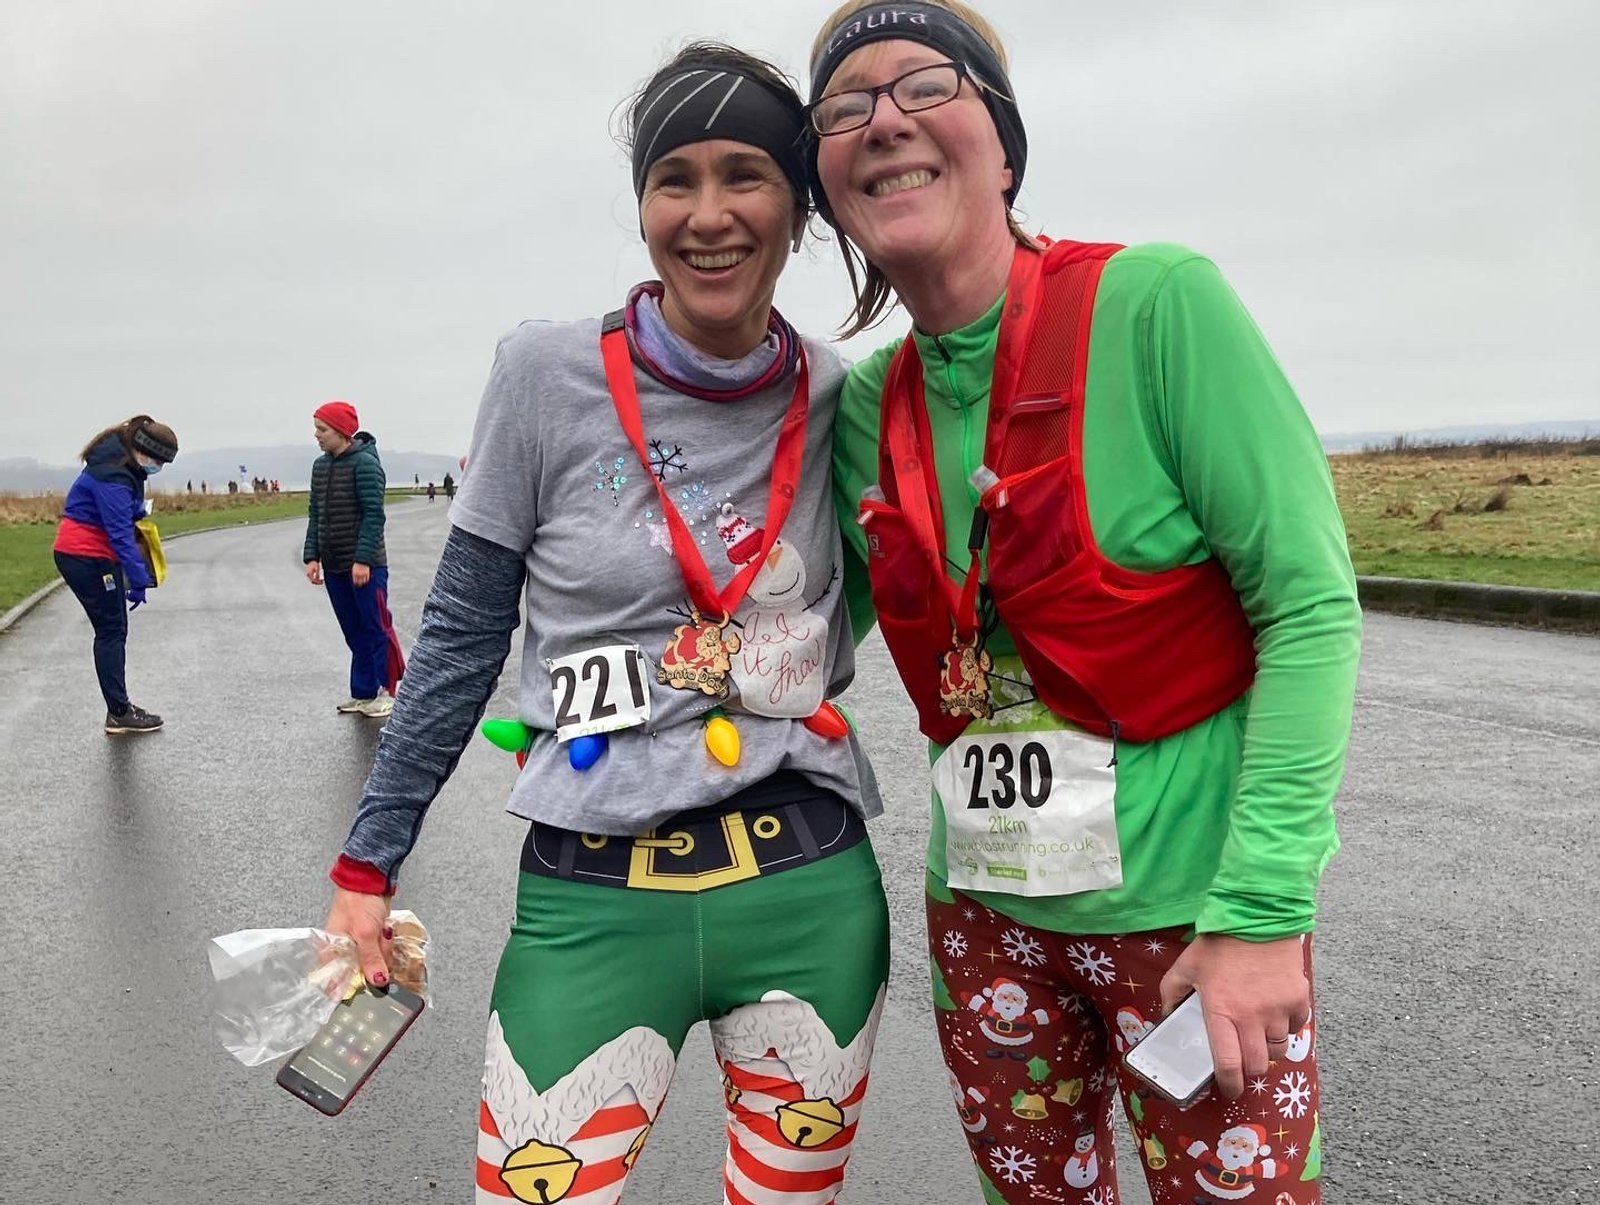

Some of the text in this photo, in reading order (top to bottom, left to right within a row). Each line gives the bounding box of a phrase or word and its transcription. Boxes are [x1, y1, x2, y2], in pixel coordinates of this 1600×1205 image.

[828, 11, 927, 55] Laura
[657, 668, 697, 685] Santa
[743, 647, 773, 677] it
[963, 741, 1053, 810] 230
[988, 815, 1027, 834] 21km
